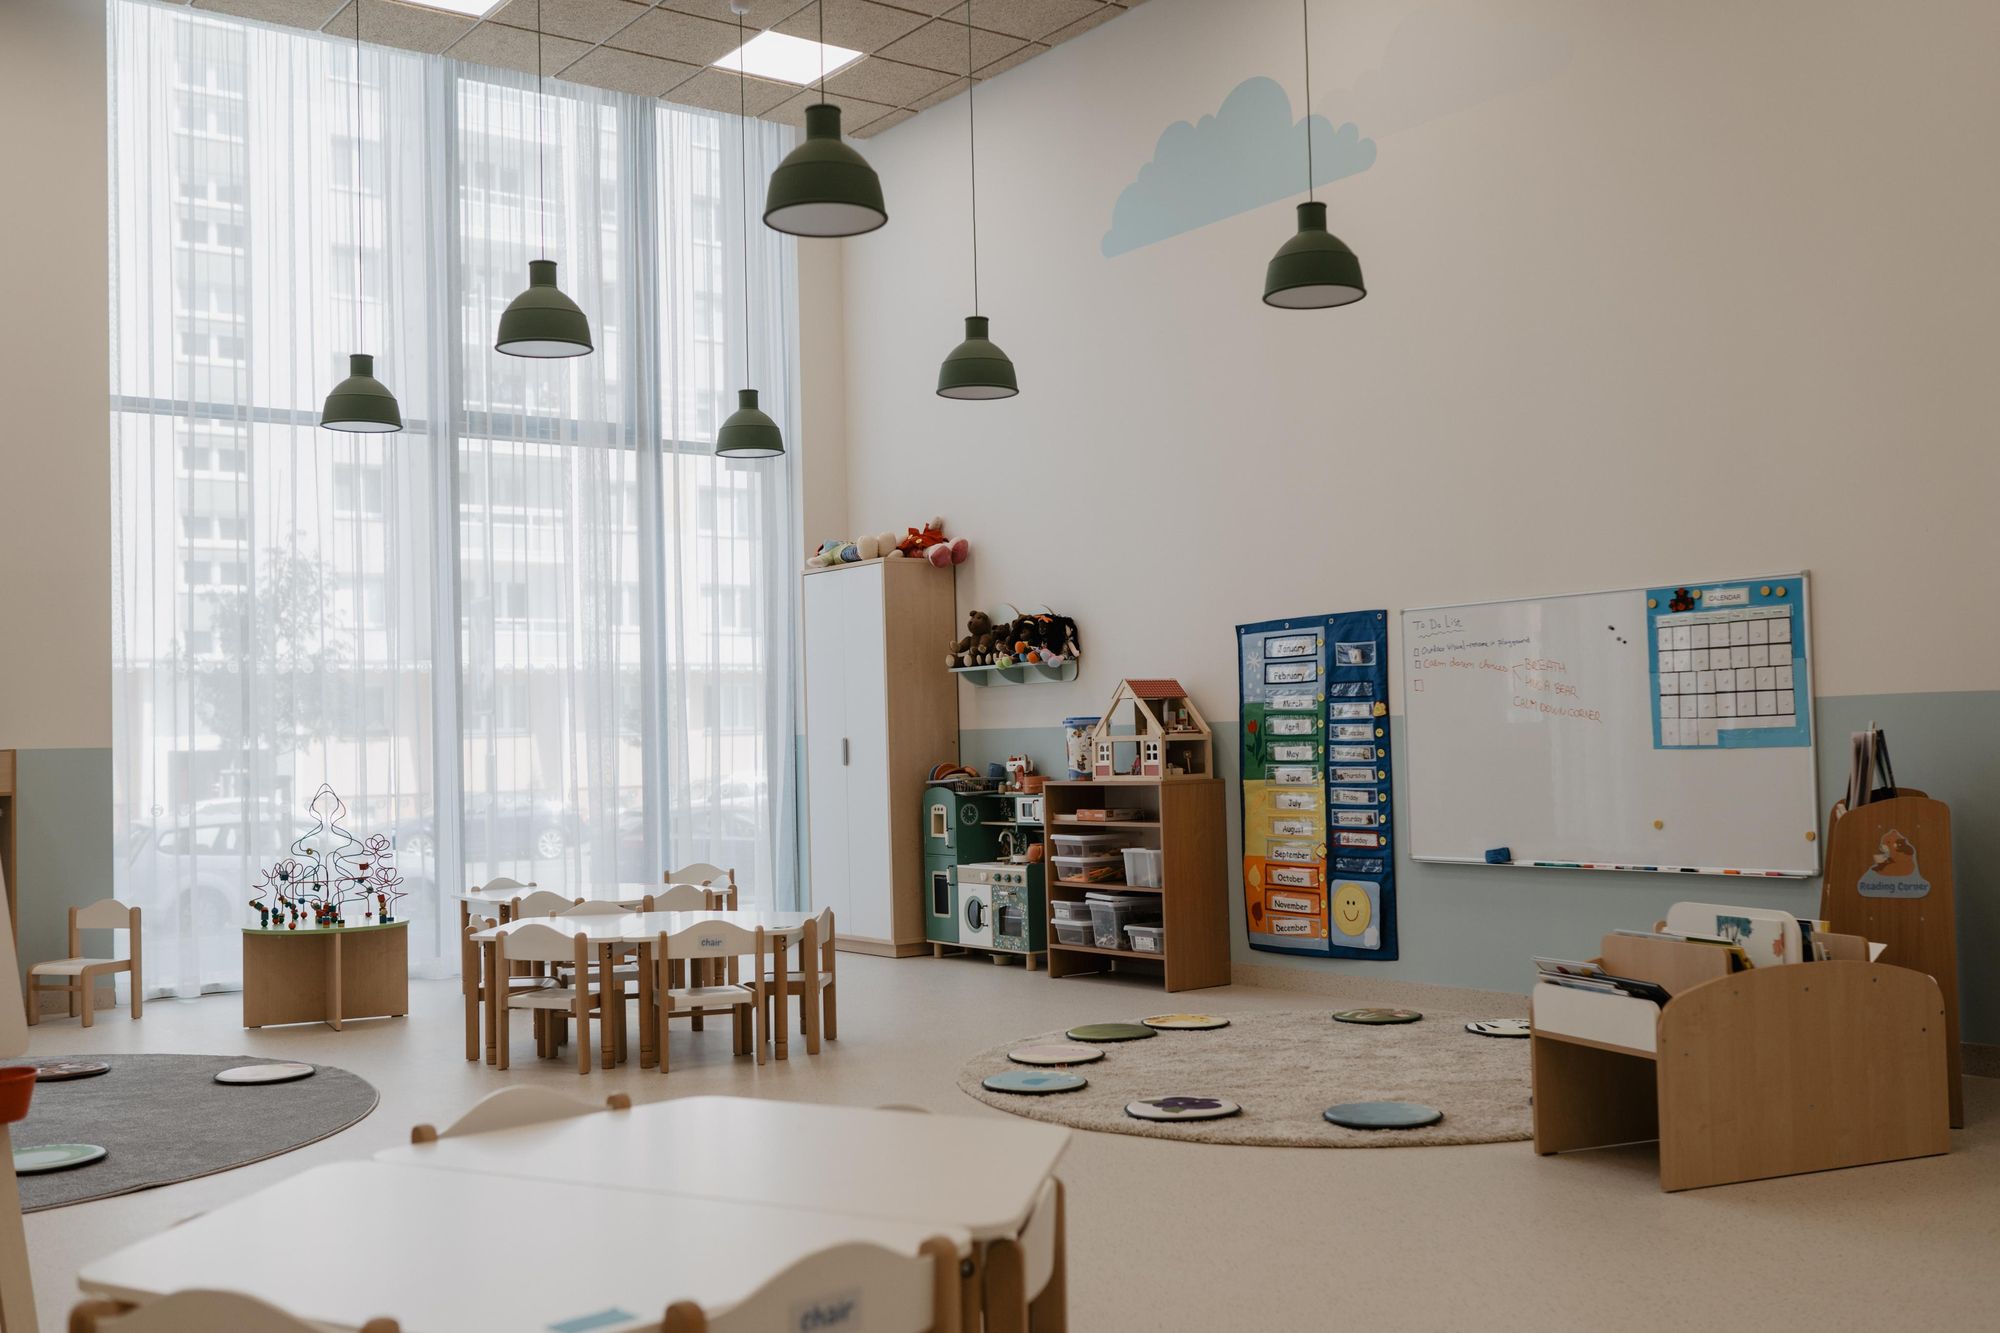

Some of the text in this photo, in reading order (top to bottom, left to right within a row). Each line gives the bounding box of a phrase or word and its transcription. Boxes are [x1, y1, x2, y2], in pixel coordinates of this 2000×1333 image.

[1709, 593, 1742, 601] CALENDAR
[1412, 615, 1462, 630] To Do List
[1277, 644, 1306, 654] January
[1274, 671, 1305, 682] February
[1286, 750, 1299, 758] May
[1286, 774, 1301, 782] June
[1343, 772, 1367, 780] Thursday
[1342, 793, 1359, 801] Friday
[1288, 799, 1302, 808] July
[1274, 849, 1309, 860] September
[1277, 873, 1304, 883] October
[1860, 882, 1929, 893] Reading Corner
[1274, 900, 1308, 911] November
[1275, 924, 1308, 932] December
[701, 937, 722, 947] chair
[799, 1300, 856, 1332] chair
